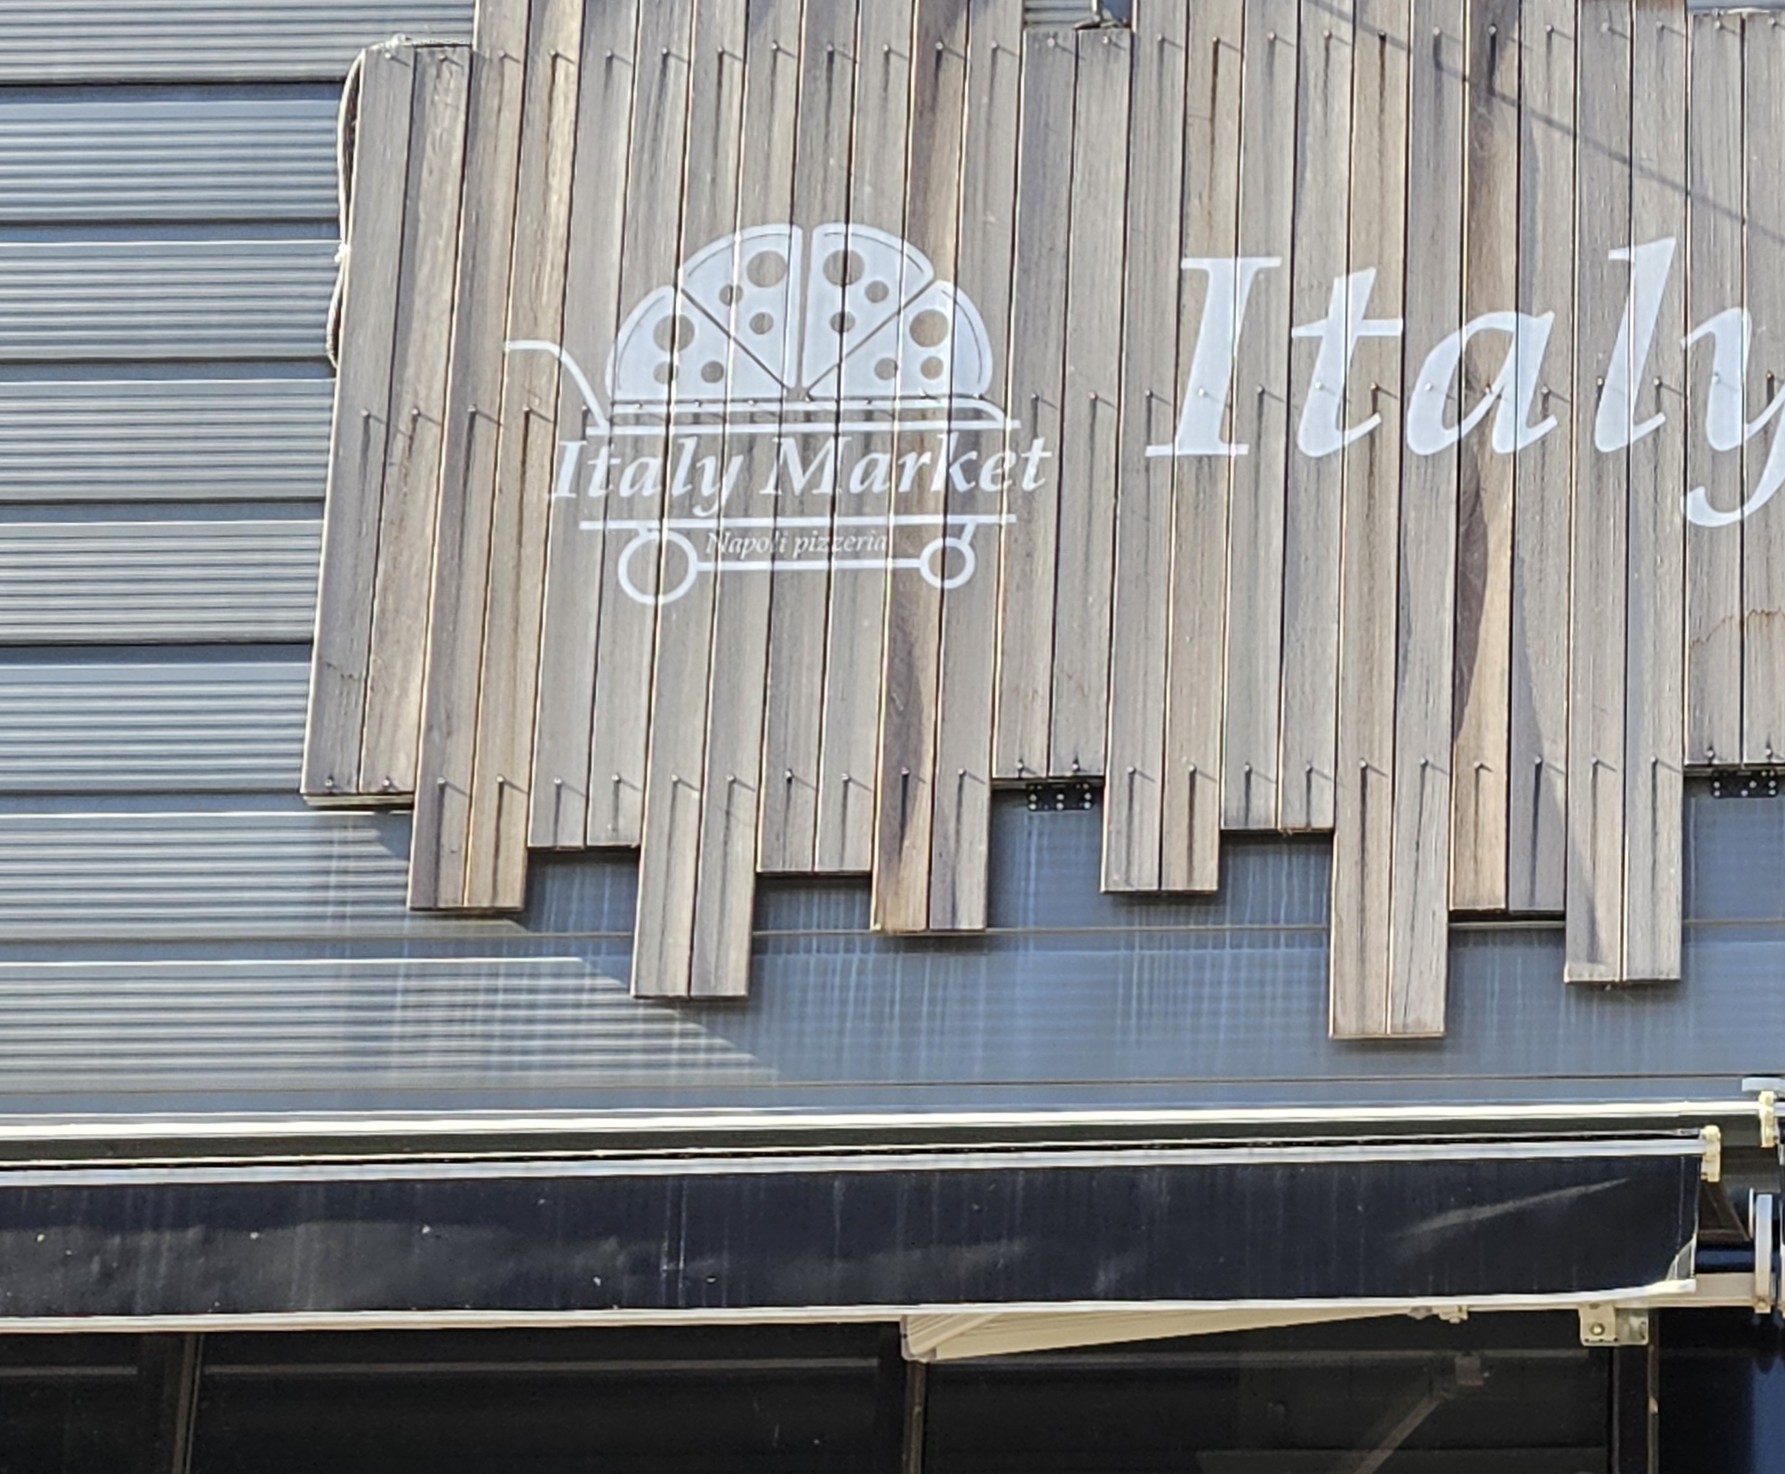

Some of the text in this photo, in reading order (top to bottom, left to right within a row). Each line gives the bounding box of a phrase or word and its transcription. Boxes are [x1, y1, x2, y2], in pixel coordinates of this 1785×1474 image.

[551, 433, 1054, 517] Italy Market
[706, 530, 788, 560] Napoli
